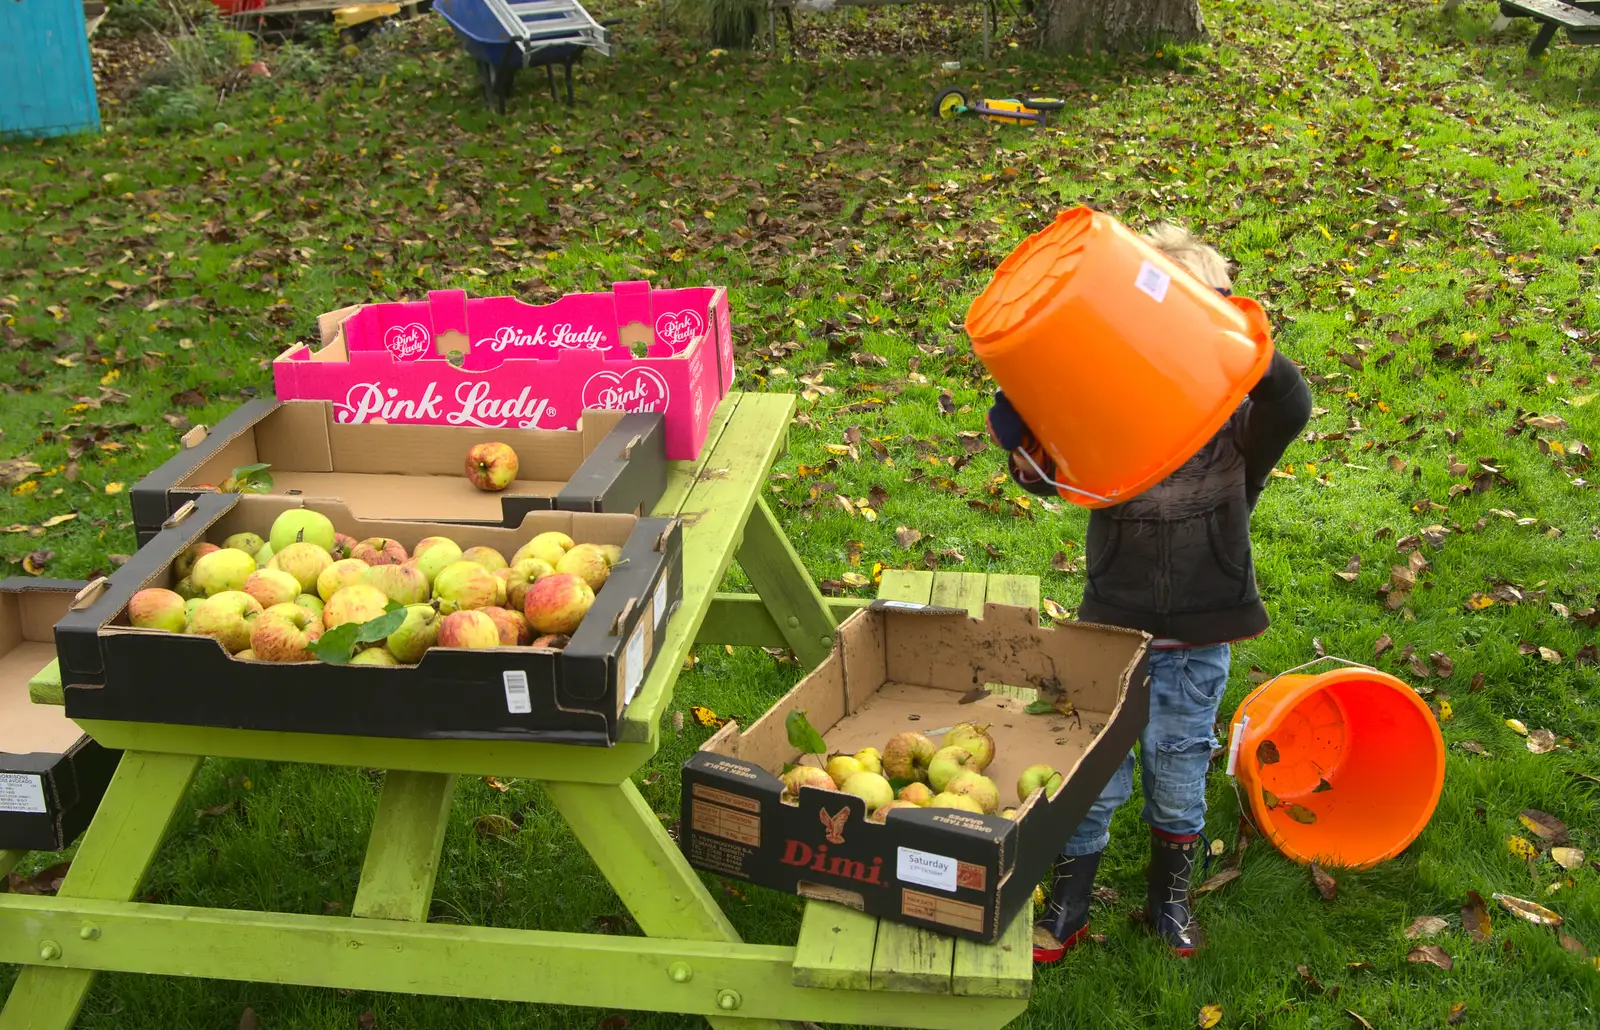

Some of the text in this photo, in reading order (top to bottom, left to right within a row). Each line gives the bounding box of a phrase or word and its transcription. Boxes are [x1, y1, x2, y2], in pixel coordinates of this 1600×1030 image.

[664, 315, 692, 337] Pink
[391, 328, 419, 350] Pink
[475, 324, 547, 352] Pink
[333, 381, 443, 424] Pink
[597, 376, 649, 410] Pink
[932, 815, 992, 833] GREEK TABLE
[948, 814, 984, 825] GRAPES
[779, 838, 883, 885] Dimi
[909, 854, 949, 871] Saturday
